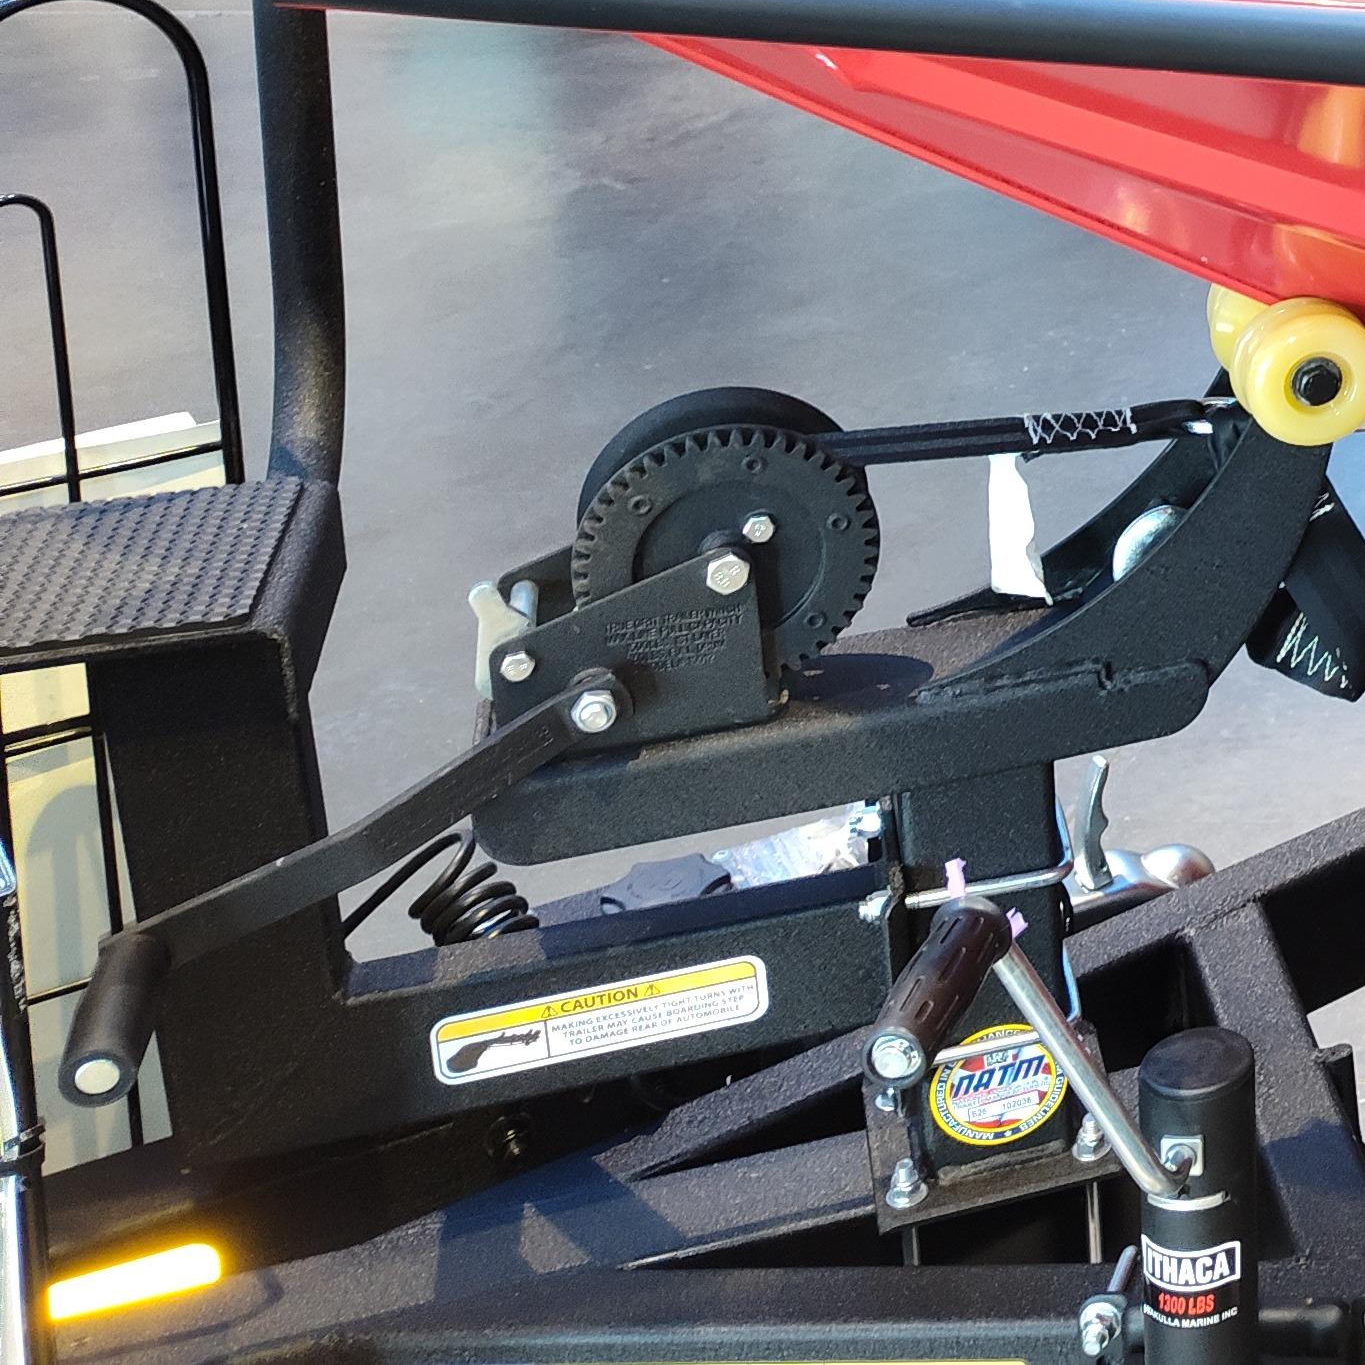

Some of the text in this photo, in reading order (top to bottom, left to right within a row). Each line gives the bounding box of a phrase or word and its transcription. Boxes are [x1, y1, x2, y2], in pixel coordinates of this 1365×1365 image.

[560, 986, 639, 1013] CAUTION
[551, 1017, 594, 1032] MAKING
[562, 1024, 604, 1038] TRAILER
[607, 1019, 628, 1030] MAY
[631, 1012, 662, 1024] CAUSE
[569, 1037, 583, 1046] TO
[585, 1027, 628, 1043] DAMAGE
[1146, 1247, 1231, 1286] ITHACA
[1158, 1292, 1215, 1316] 1300 LBS
[1181, 1313, 1221, 1329] MARINE
[1221, 1306, 1238, 1321] INC
